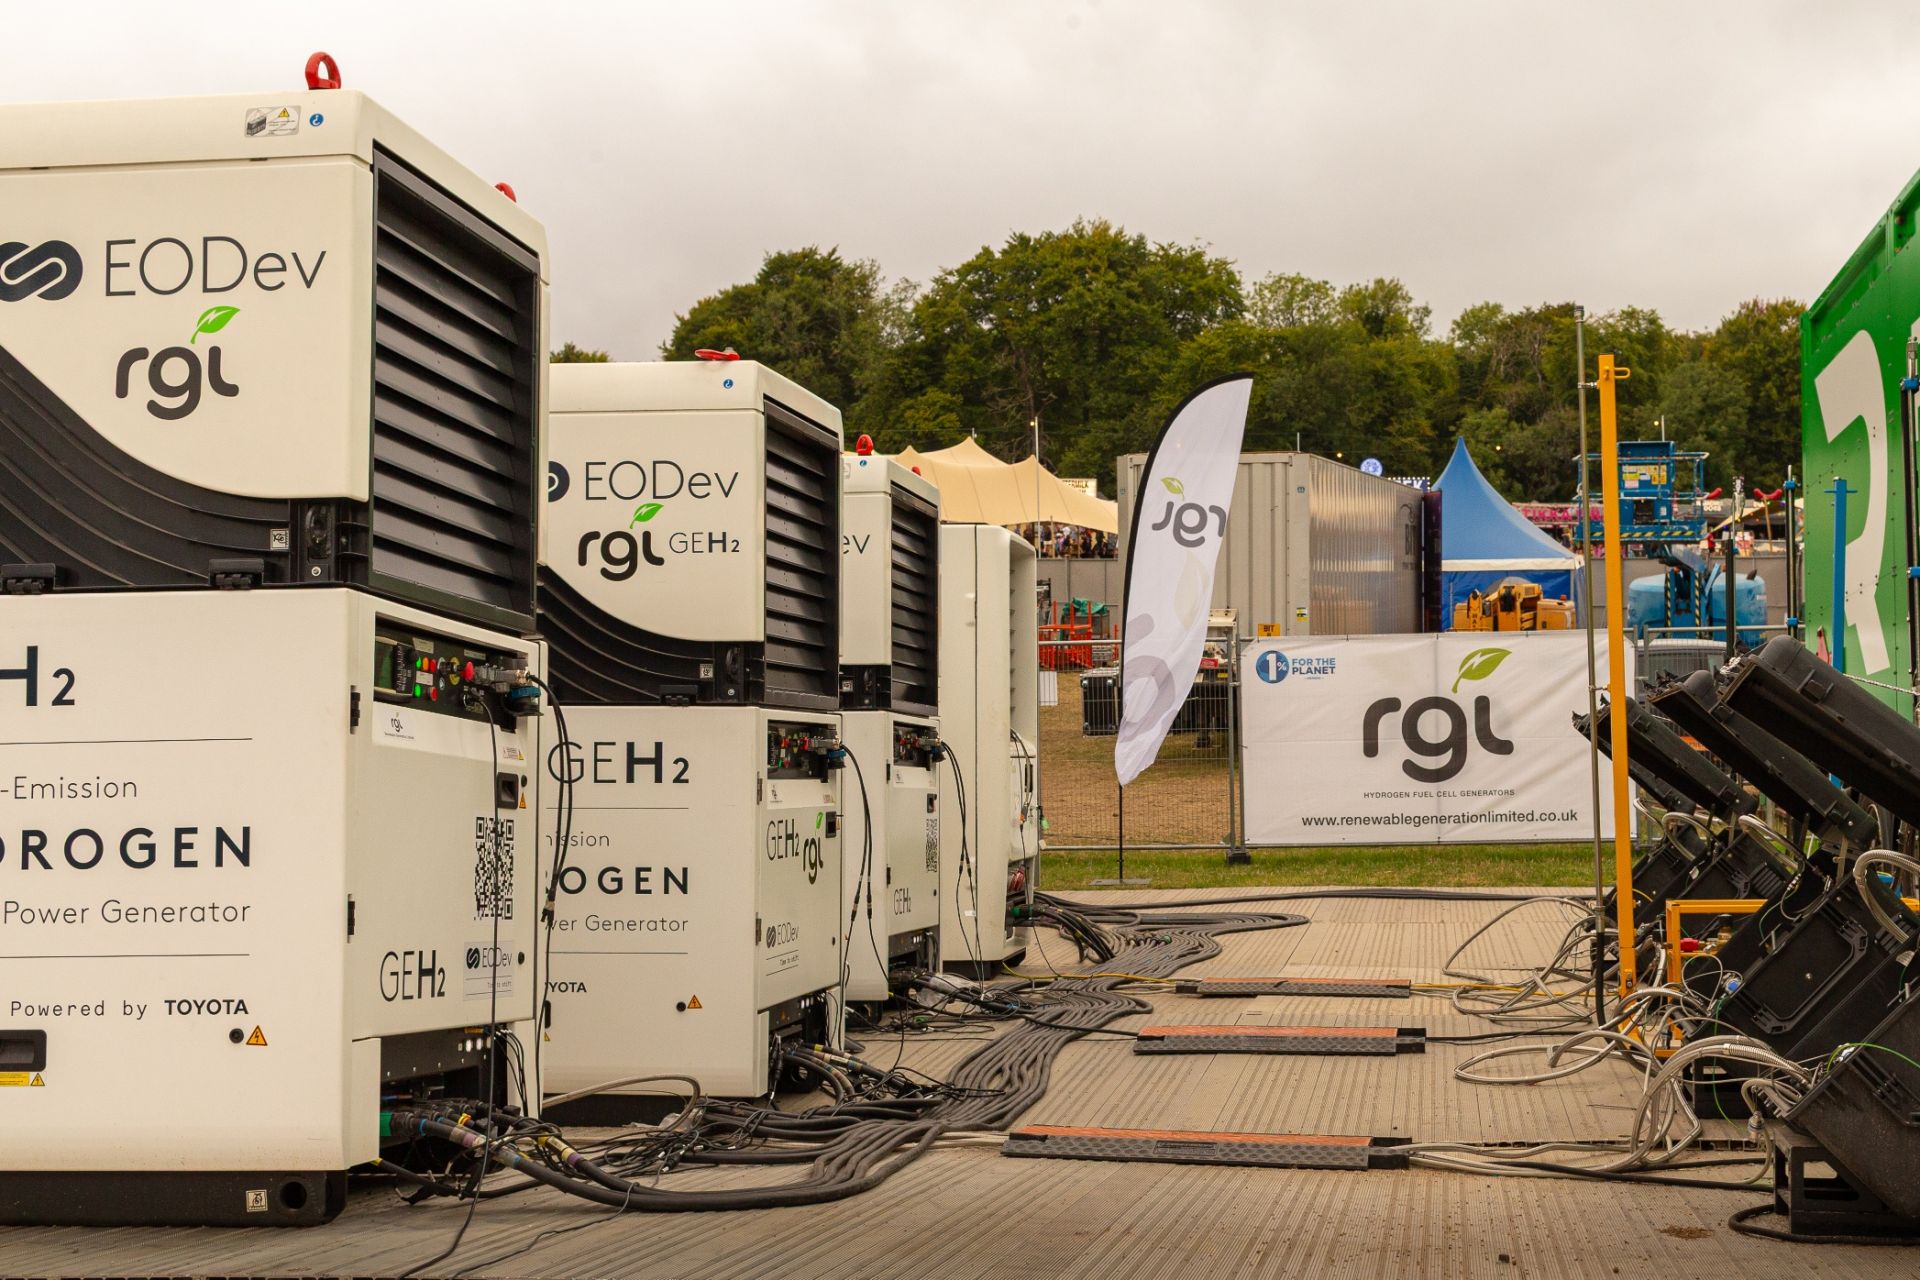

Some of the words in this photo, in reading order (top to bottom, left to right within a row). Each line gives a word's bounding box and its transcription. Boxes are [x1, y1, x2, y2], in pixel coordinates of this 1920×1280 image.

[106, 236, 327, 297] EODev
[115, 345, 240, 421] rgl
[585, 459, 739, 500] EODev
[578, 530, 666, 582] rgl
[669, 531, 740, 553] GEH2
[1292, 658, 1313, 666] FOR
[1315, 657, 1336, 666] THE
[1292, 666, 1336, 675] PLANET
[1363, 695, 1514, 783] rgl
[547, 741, 690, 784] GEH2
[0, 776, 137, 800] -Emission
[1363, 791, 1410, 799] HYDROGEN
[1436, 790, 1457, 798] CELL
[1459, 789, 1515, 797] GENERATORS
[1302, 808, 1578, 828] www.renewablegenerationlimited.co.uk
[0, 826, 251, 870] ROGEN
[546, 831, 610, 847] ssion
[766, 819, 800, 861] GEH2
[803, 837, 824, 885] rgl
[545, 866, 689, 895] OGEN
[3, 900, 90, 924] Power
[101, 899, 251, 923] Generator
[585, 914, 689, 931] Generator
[379, 950, 446, 1002] GEH2
[545, 981, 587, 993] YOTA
[10, 1000, 105, 1017] Powered
[123, 999, 147, 1020] by
[164, 999, 249, 1015] TOYOTA
